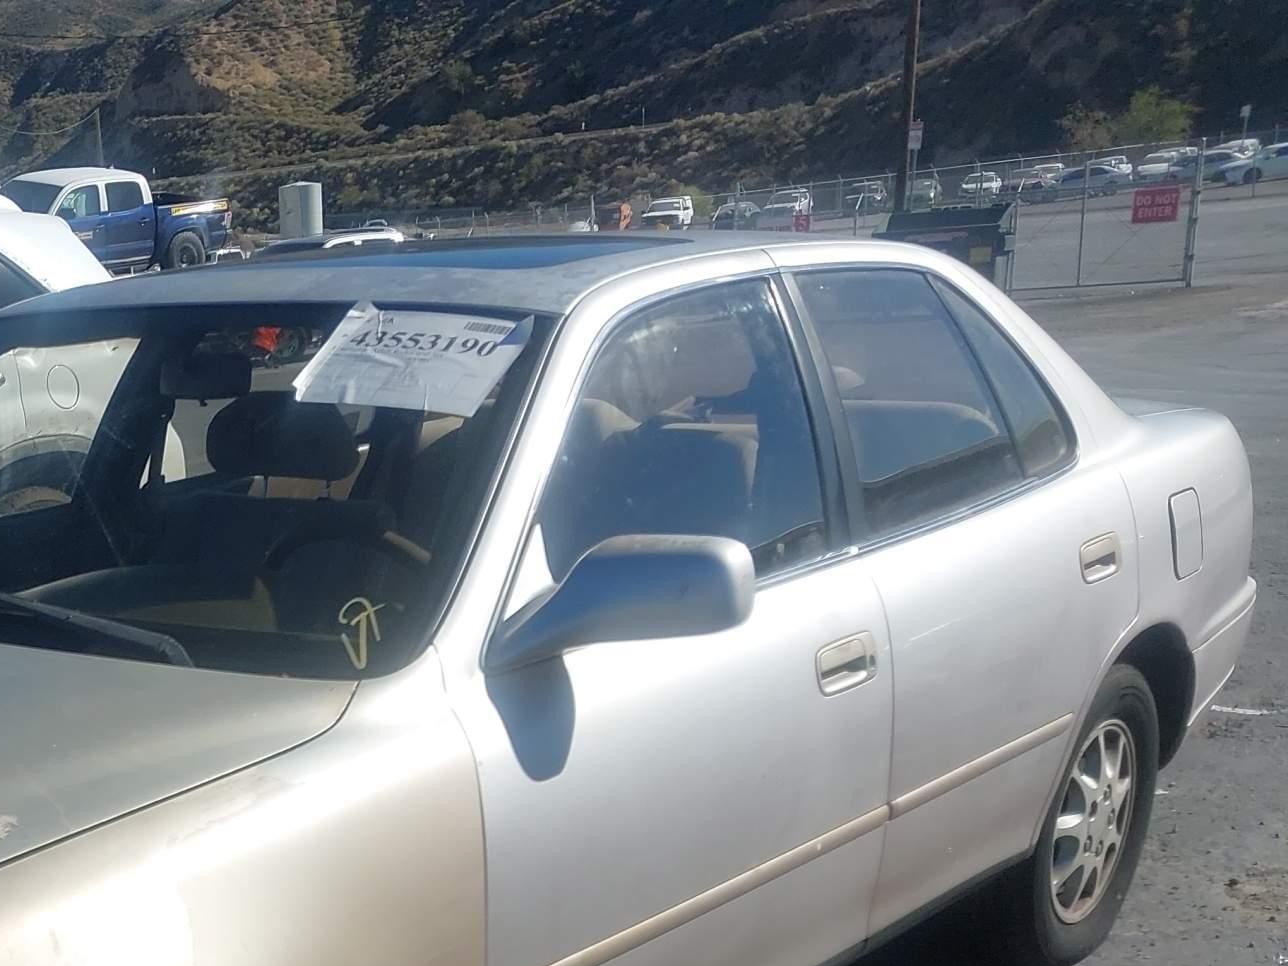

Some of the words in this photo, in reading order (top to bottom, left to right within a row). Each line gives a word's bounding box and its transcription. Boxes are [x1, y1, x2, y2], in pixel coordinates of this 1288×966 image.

[1135, 195, 1153, 207] DO
[1155, 191, 1180, 205] NOT
[1138, 206, 1173, 218] ENTER
[349, 329, 497, 357] 43553190
